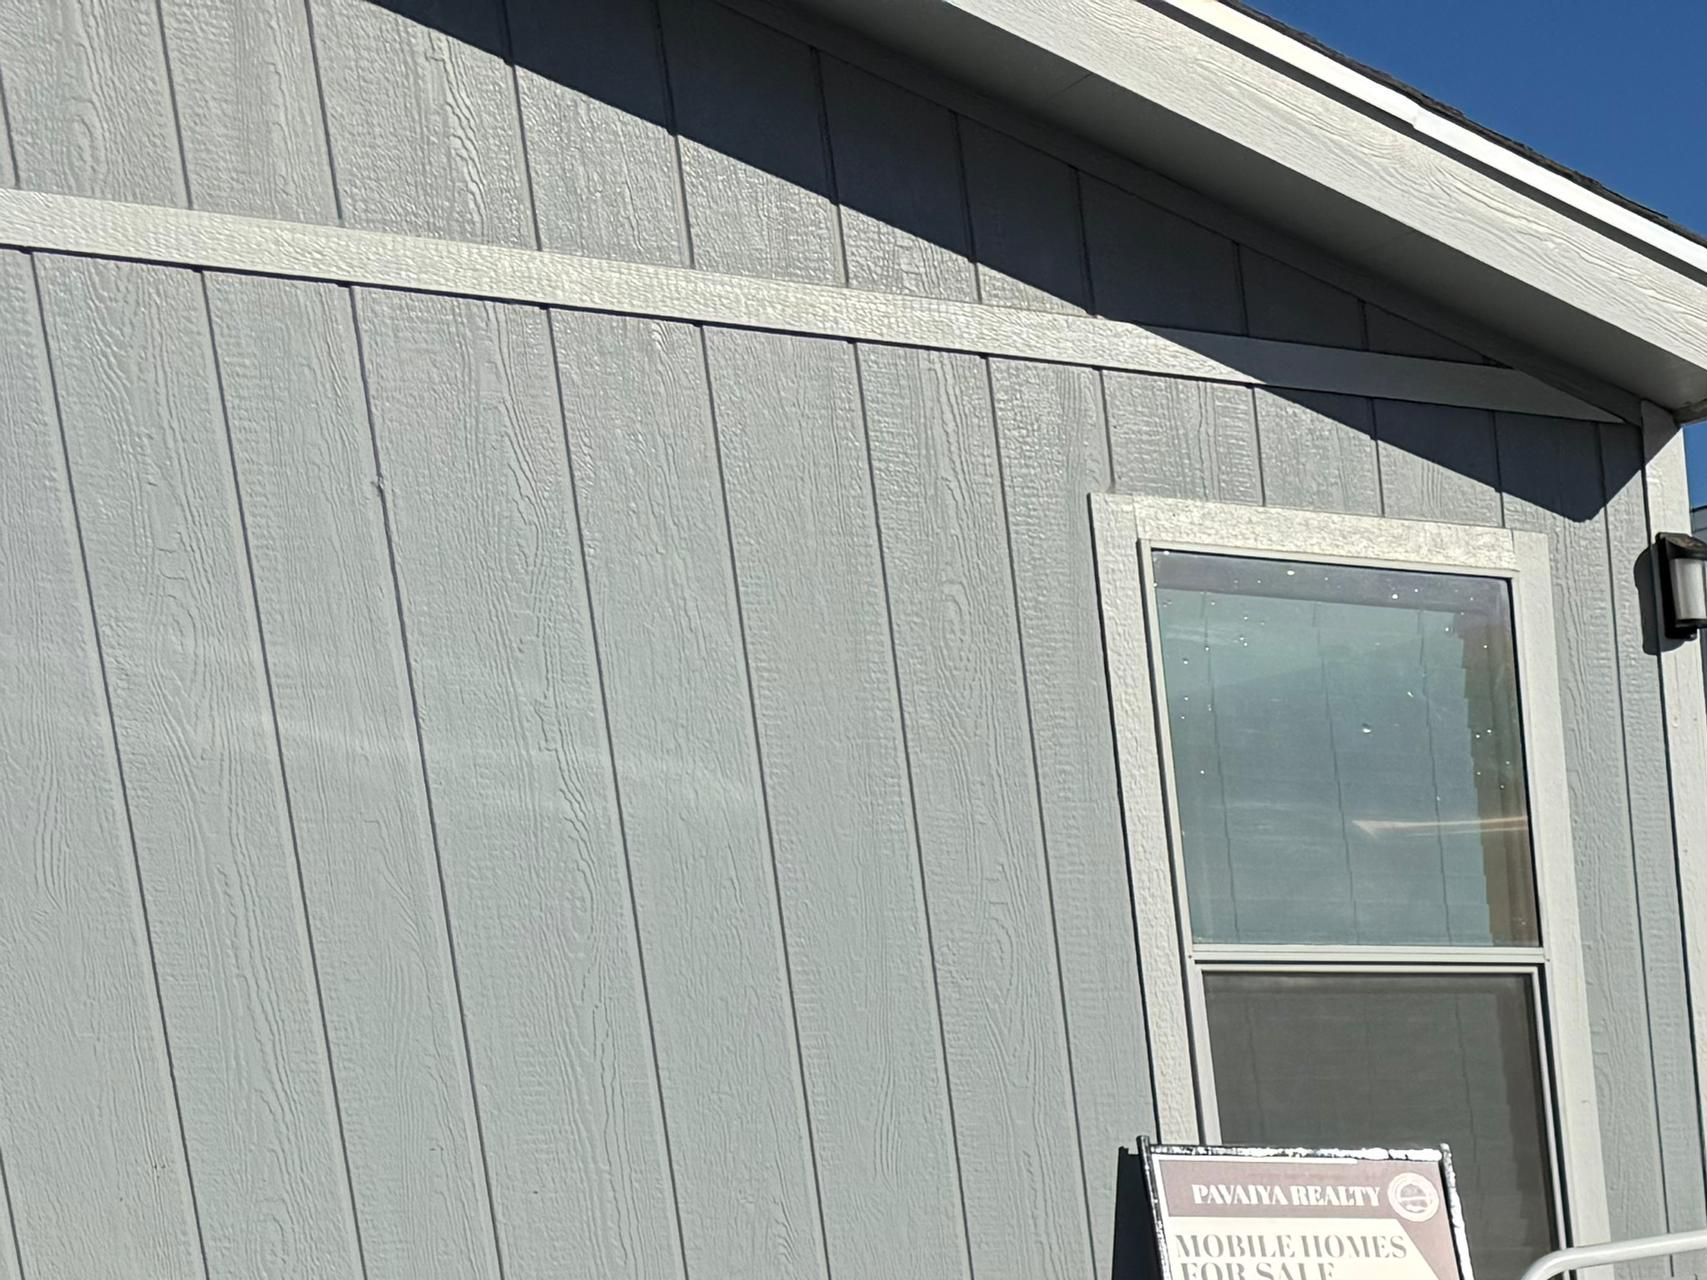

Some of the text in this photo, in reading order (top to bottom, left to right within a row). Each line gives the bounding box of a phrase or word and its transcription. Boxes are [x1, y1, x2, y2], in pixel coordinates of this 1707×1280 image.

[1191, 1184, 1381, 1207] PAVAIYA REALTY
[1176, 1234, 1408, 1259] MOBILE HOMES
